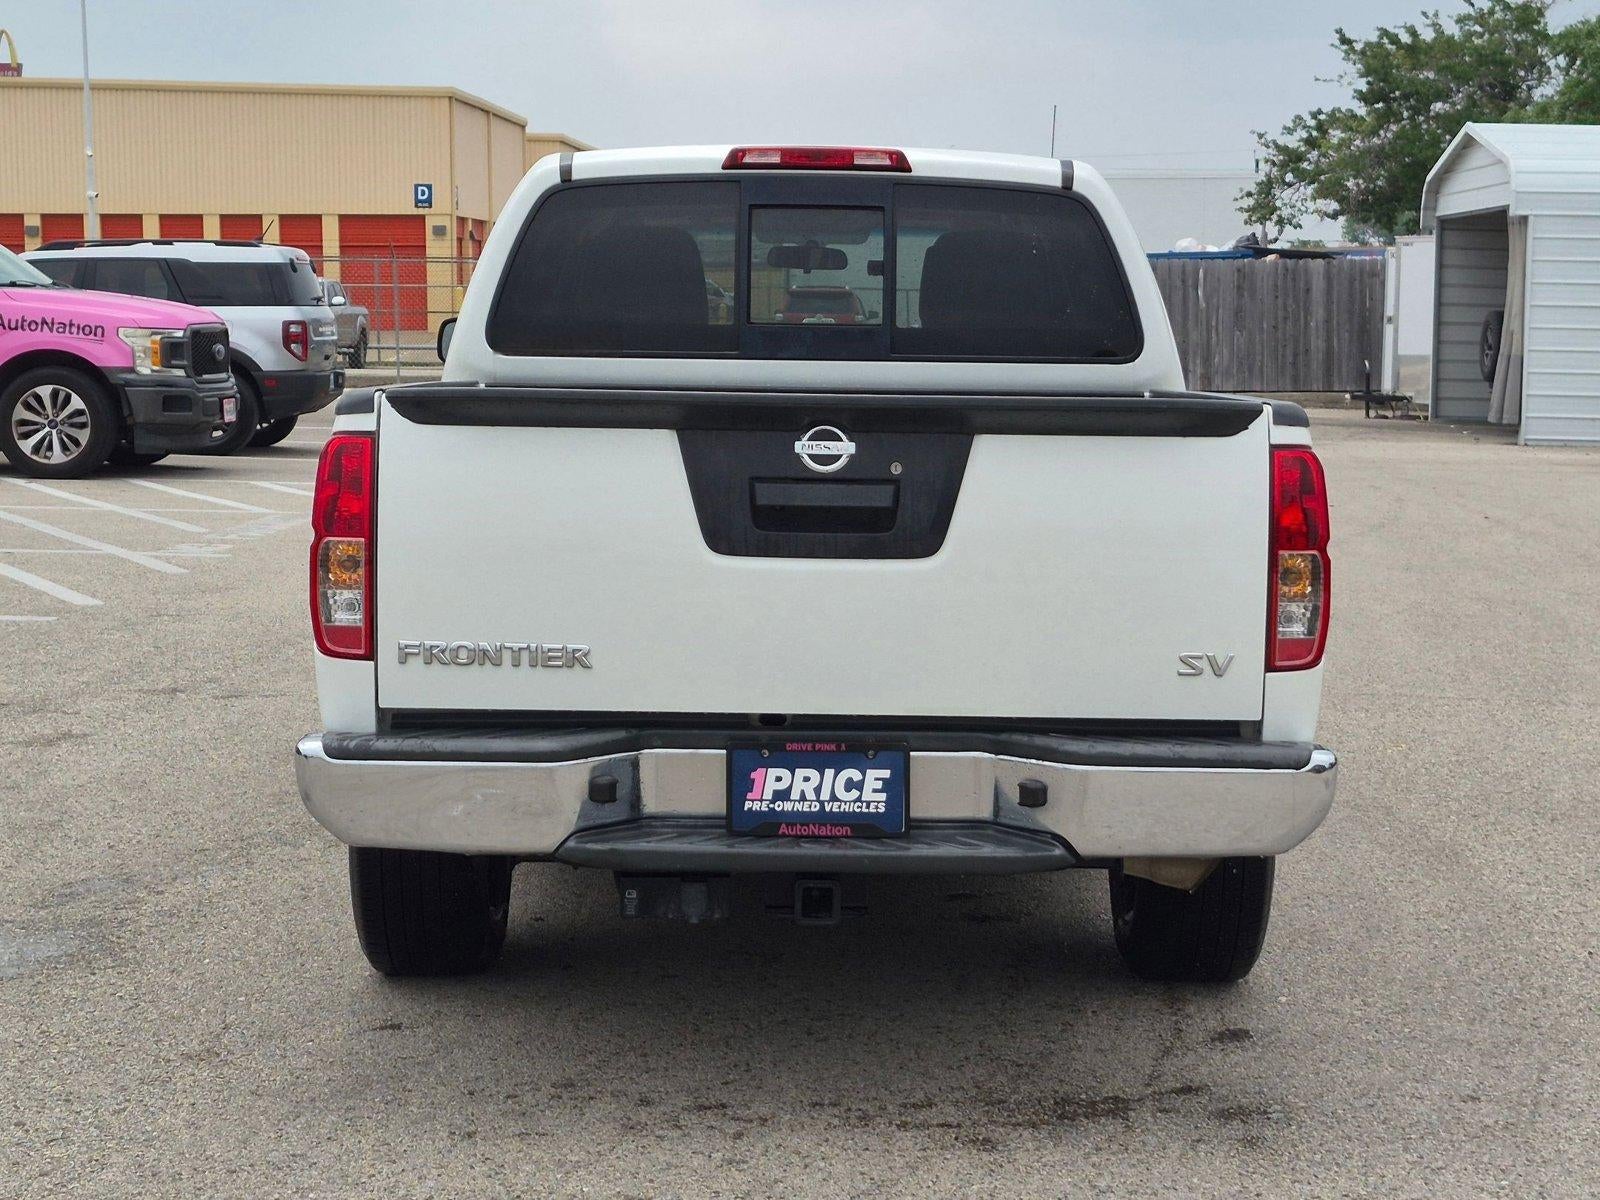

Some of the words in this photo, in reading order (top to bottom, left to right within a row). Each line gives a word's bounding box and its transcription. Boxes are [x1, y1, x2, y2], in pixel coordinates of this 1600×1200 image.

[417, 186, 429, 200] D
[0, 313, 105, 338] AutoNation
[801, 443, 847, 452] NISS
[398, 640, 592, 669] FRONTIER
[1177, 652, 1235, 677] SV
[786, 743, 813, 751] DRIVE
[815, 743, 837, 751] PINK
[744, 800, 820, 812] PRE-OWNED
[824, 801, 886, 813] VEHICLES
[778, 823, 851, 836] AutoNation
